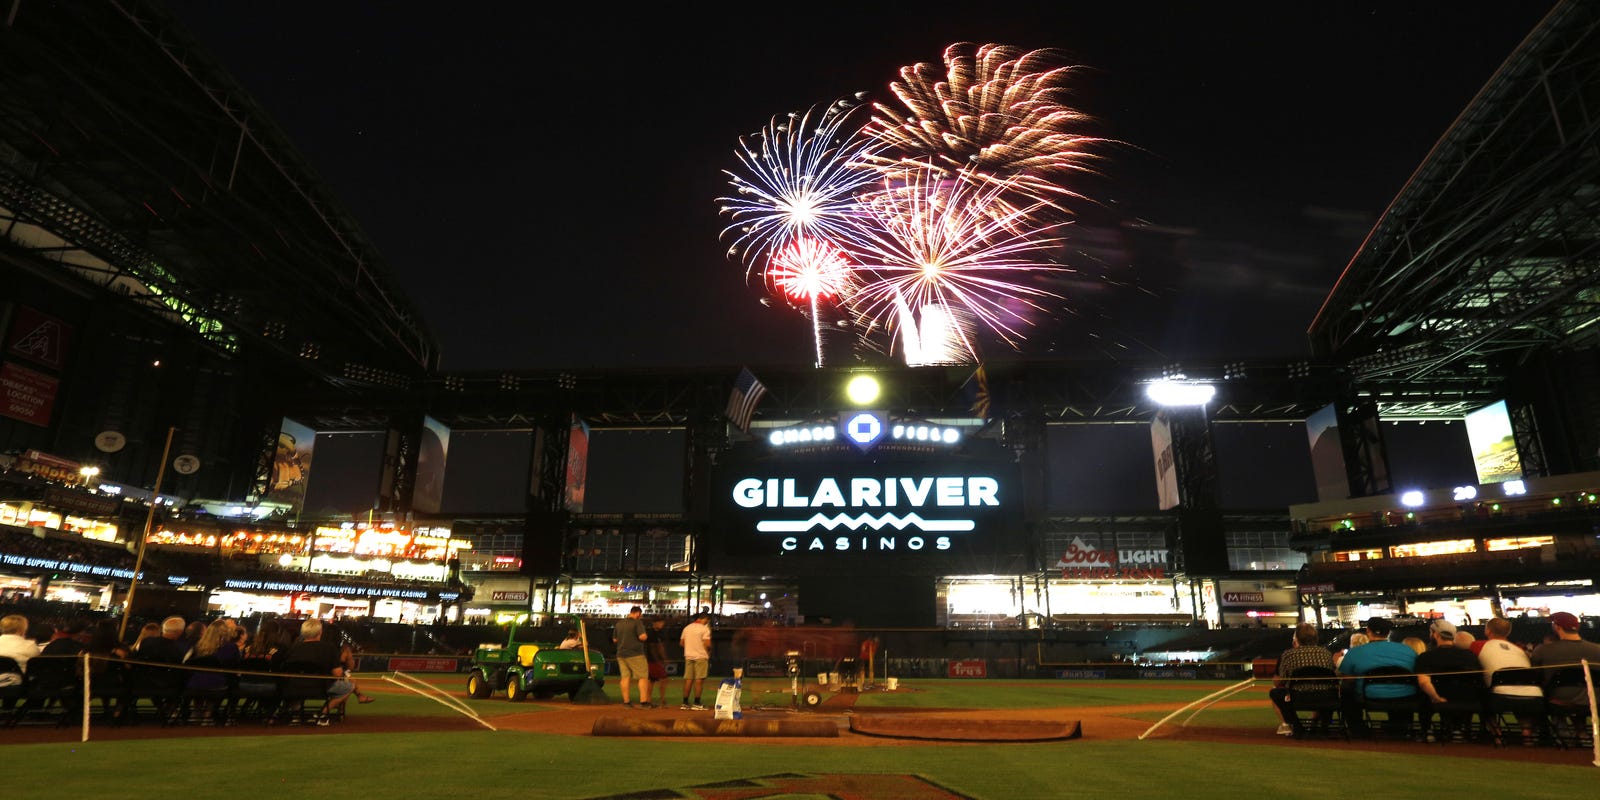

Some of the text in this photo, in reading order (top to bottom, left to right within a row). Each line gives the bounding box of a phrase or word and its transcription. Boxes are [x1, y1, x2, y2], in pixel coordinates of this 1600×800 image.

[769, 424, 960, 446] CHASE FIELD
[781, 536, 951, 551] CASINOS
[3, 554, 26, 567] THEIR
[26, 557, 59, 570] SUPPORT
[59, 561, 69, 572] OF
[69, 563, 92, 574] FRIDAY
[92, 565, 111, 576] NIGHT
[1118, 549, 1169, 564] LIGHT
[1061, 566, 1165, 580] STRIKE ZONE
[225, 579, 262, 590] TONIGHT'S
[263, 581, 303, 592] FIREWORKS
[303, 584, 318, 593] ARE
[318, 585, 356, 596] PRESENTED
[356, 587, 366, 596] BY
[367, 588, 382, 597] GILA
[382, 588, 400, 598] RIVER
[401, 589, 428, 600] CASINOS
